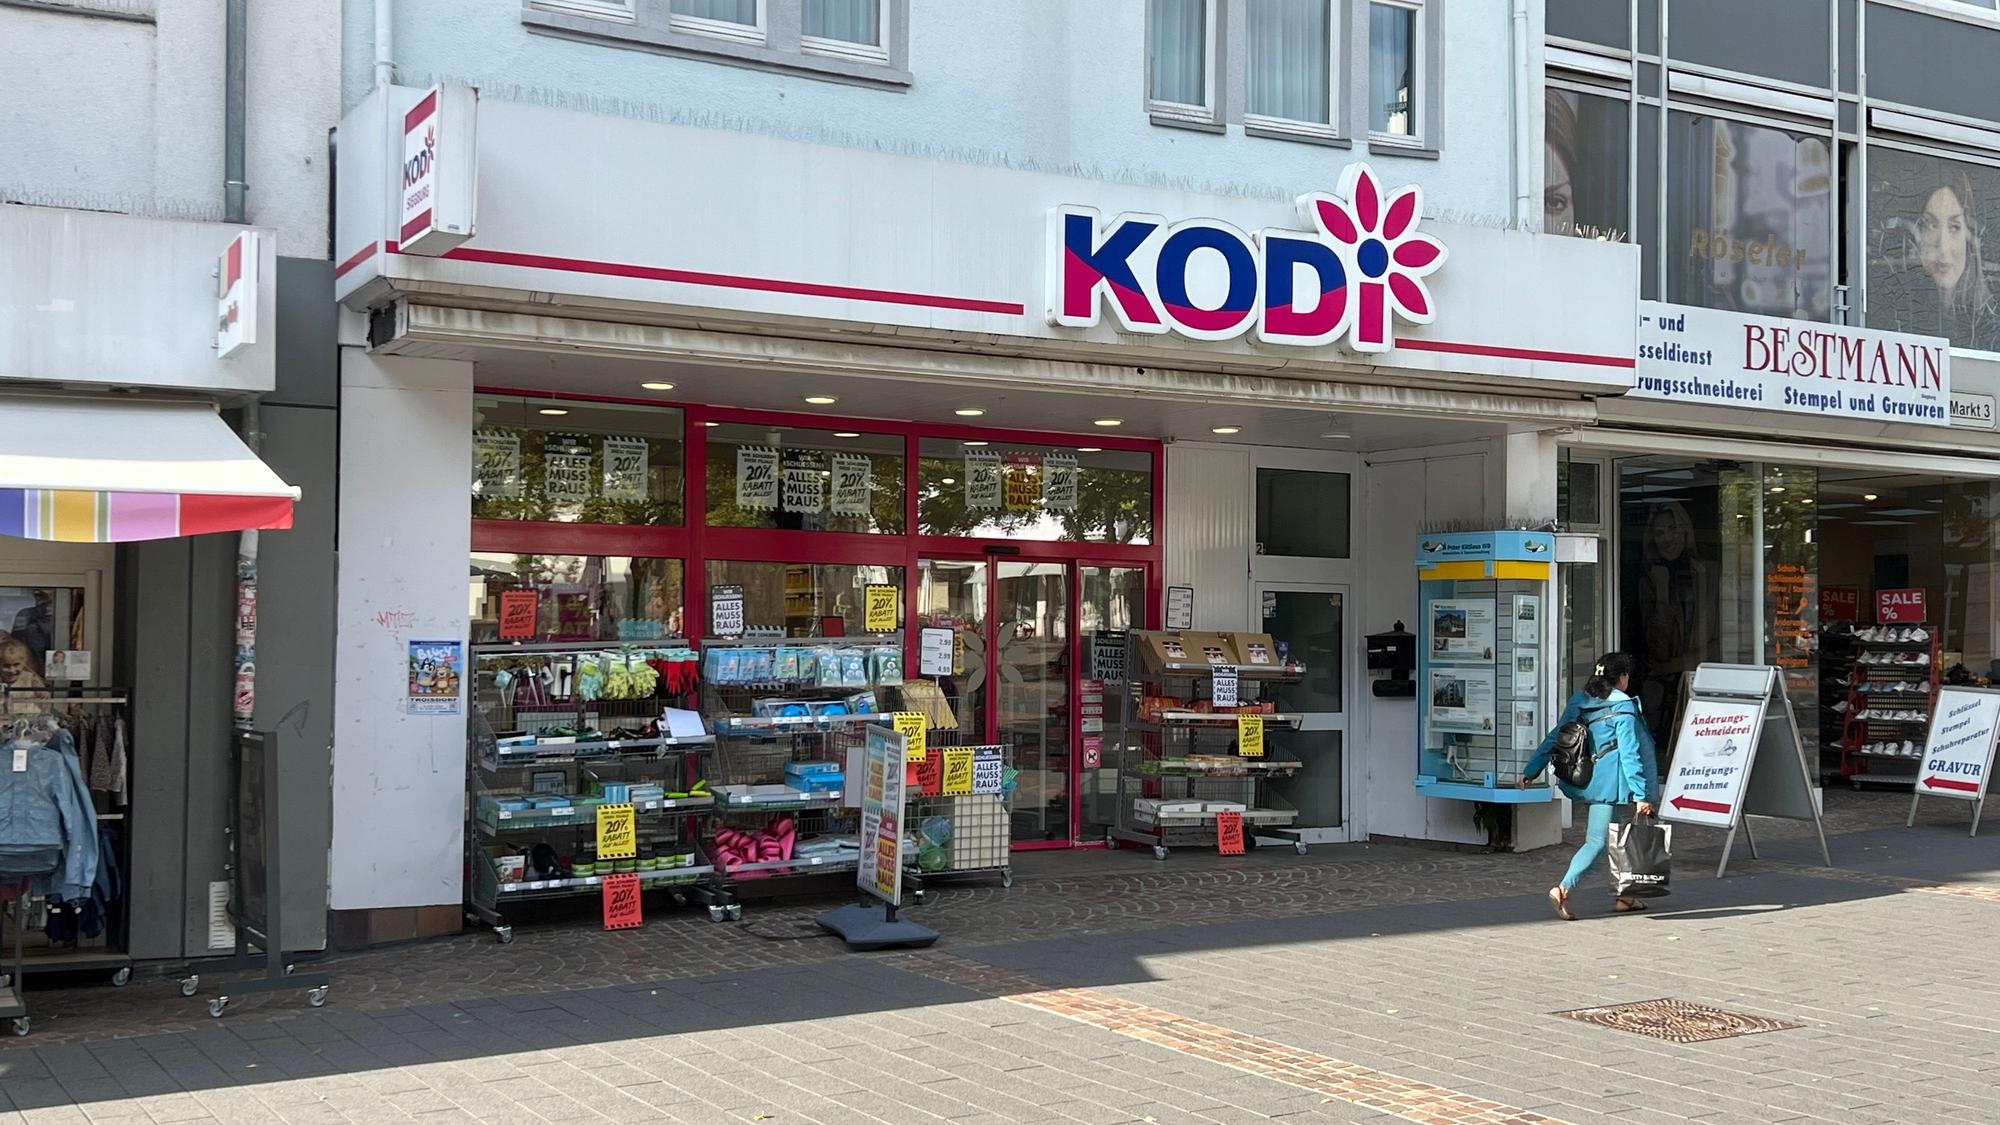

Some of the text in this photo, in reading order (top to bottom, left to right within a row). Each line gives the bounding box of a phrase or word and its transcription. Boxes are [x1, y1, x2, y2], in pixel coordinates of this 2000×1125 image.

[1659, 313, 1685, 332] und
[1639, 341, 1712, 366] sseldienst
[1743, 324, 1942, 392] BESTMANN
[1784, 385, 1842, 411] Stempel
[1850, 394, 1875, 413] und
[1882, 396, 1945, 419] Gravuren
[1950, 400, 1991, 418] Markt 3
[550, 457, 586, 469] ALLES
[613, 456, 641, 472] 20%
[550, 470, 586, 482] MUSS
[746, 464, 772, 481] 20%
[787, 471, 820, 483] ALLES
[1051, 471, 1072, 486] 20%
[742, 481, 774, 491] RABATT
[840, 472, 865, 489] 20%
[549, 482, 586, 494] RAUS
[787, 484, 820, 495] MUSS
[836, 489, 867, 499] RABATT
[1009, 484, 1038, 494] MUSS
[787, 495, 820, 507] RAUS
[1256, 543, 1262, 554] 2
[1823, 590, 1856, 603] SALE
[1881, 592, 1922, 605] SALE
[716, 602, 740, 611] ALLES
[872, 597, 893, 610] 20%
[507, 603, 531, 617] 20%
[716, 611, 740, 620] MUSS
[870, 610, 893, 618] RABATT
[1882, 606, 1898, 620] %
[716, 620, 740, 629] RAUS
[1098, 648, 1124, 659] ALLES
[1097, 660, 1124, 670] MUSS
[1097, 670, 1123, 681] RAUS
[1948, 698, 1981, 718] Schlüssel
[1690, 713, 1749, 726] Änderungs-
[901, 725, 921, 738] 20%
[1244, 726, 1259, 737] 20%
[1694, 724, 1751, 737] schneiderei
[1941, 717, 1971, 735] Stempel
[1932, 727, 1990, 755] Schuhreparatur
[916, 762, 936, 775] 20%
[949, 760, 967, 774] 20%
[976, 762, 998, 771] ALLES
[1679, 766, 1738, 777] Reinigungs-
[1928, 759, 1982, 776] GRAVUR
[976, 771, 998, 780] MUSS
[975, 780, 998, 789] RAUS
[1683, 780, 1729, 790] annahme
[605, 818, 629, 835] 20%
[1223, 824, 1238, 835] 20%
[602, 831, 631, 843] RABATT
[611, 888, 634, 905] 20%
